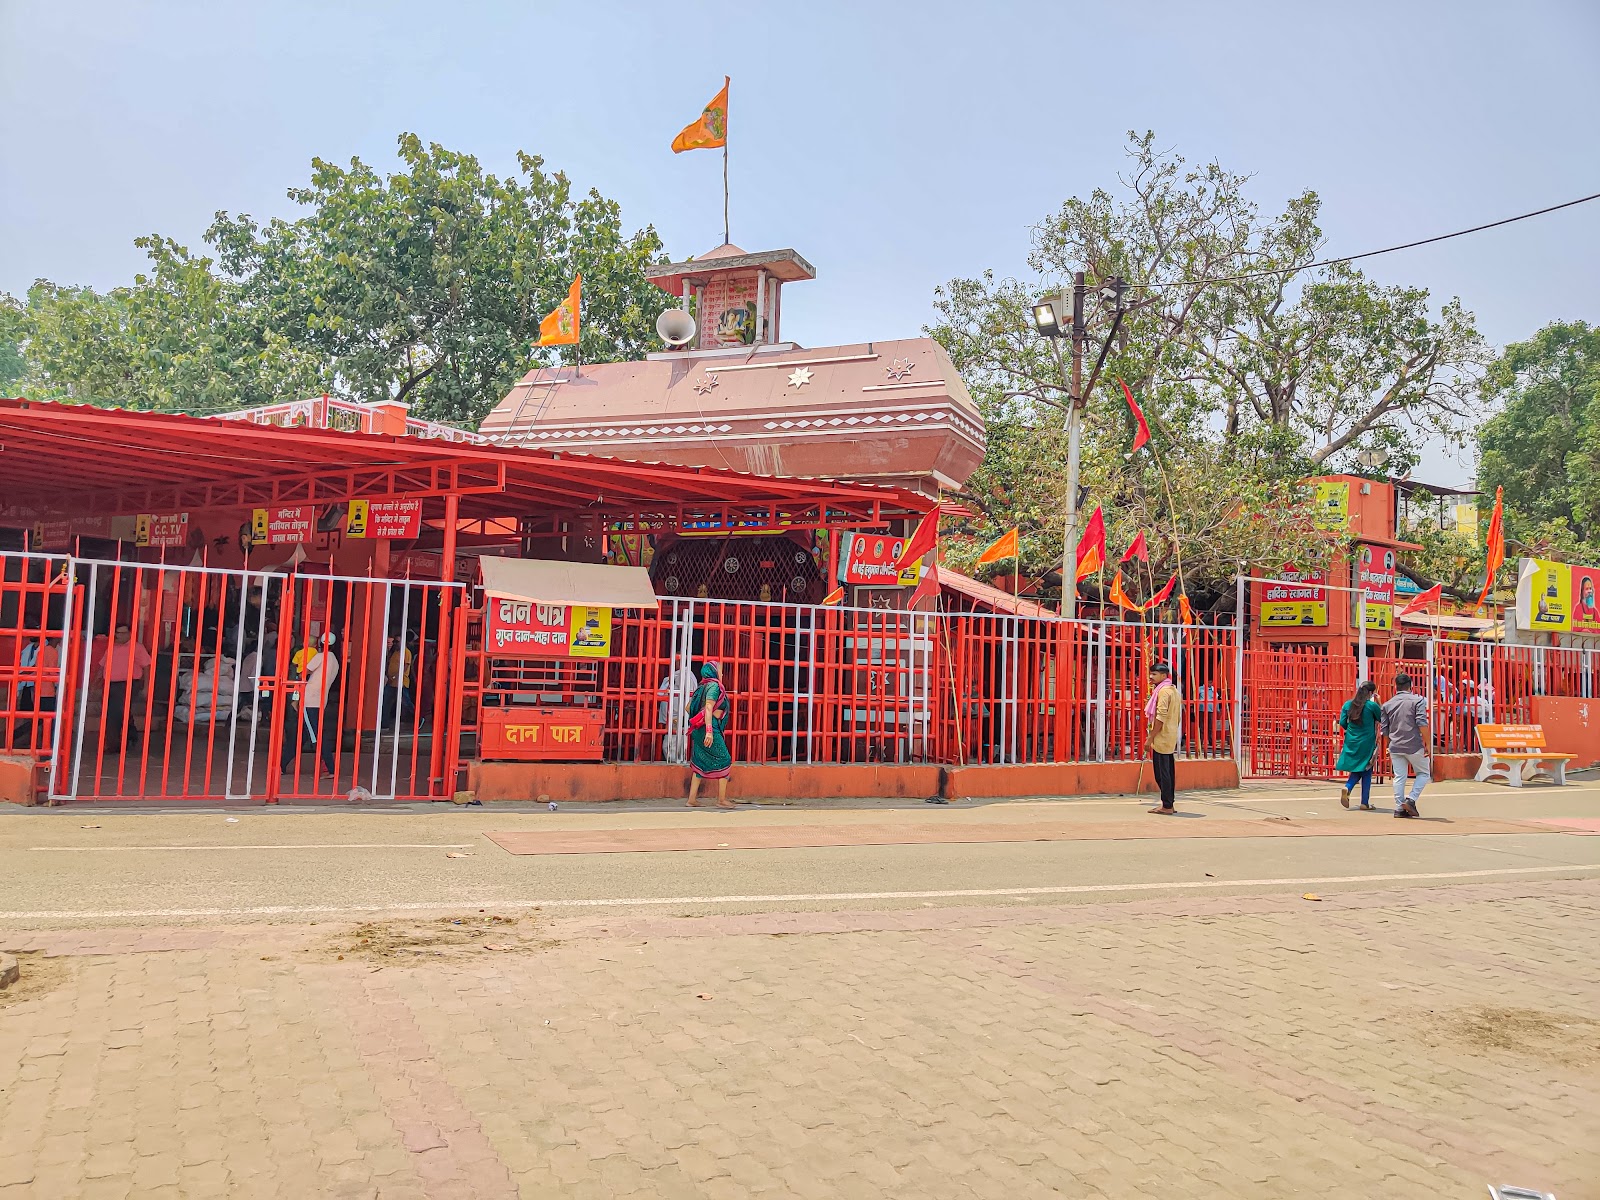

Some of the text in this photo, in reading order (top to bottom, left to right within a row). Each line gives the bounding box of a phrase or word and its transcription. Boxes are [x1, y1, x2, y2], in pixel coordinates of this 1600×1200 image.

[269, 520, 290, 530] नारियल
[299, 531, 304, 542] है
[500, 599, 567, 627] दान पात्र
[496, 629, 567, 648] गुप्त दान-महा दान
[505, 725, 583, 744] दान पात्र
